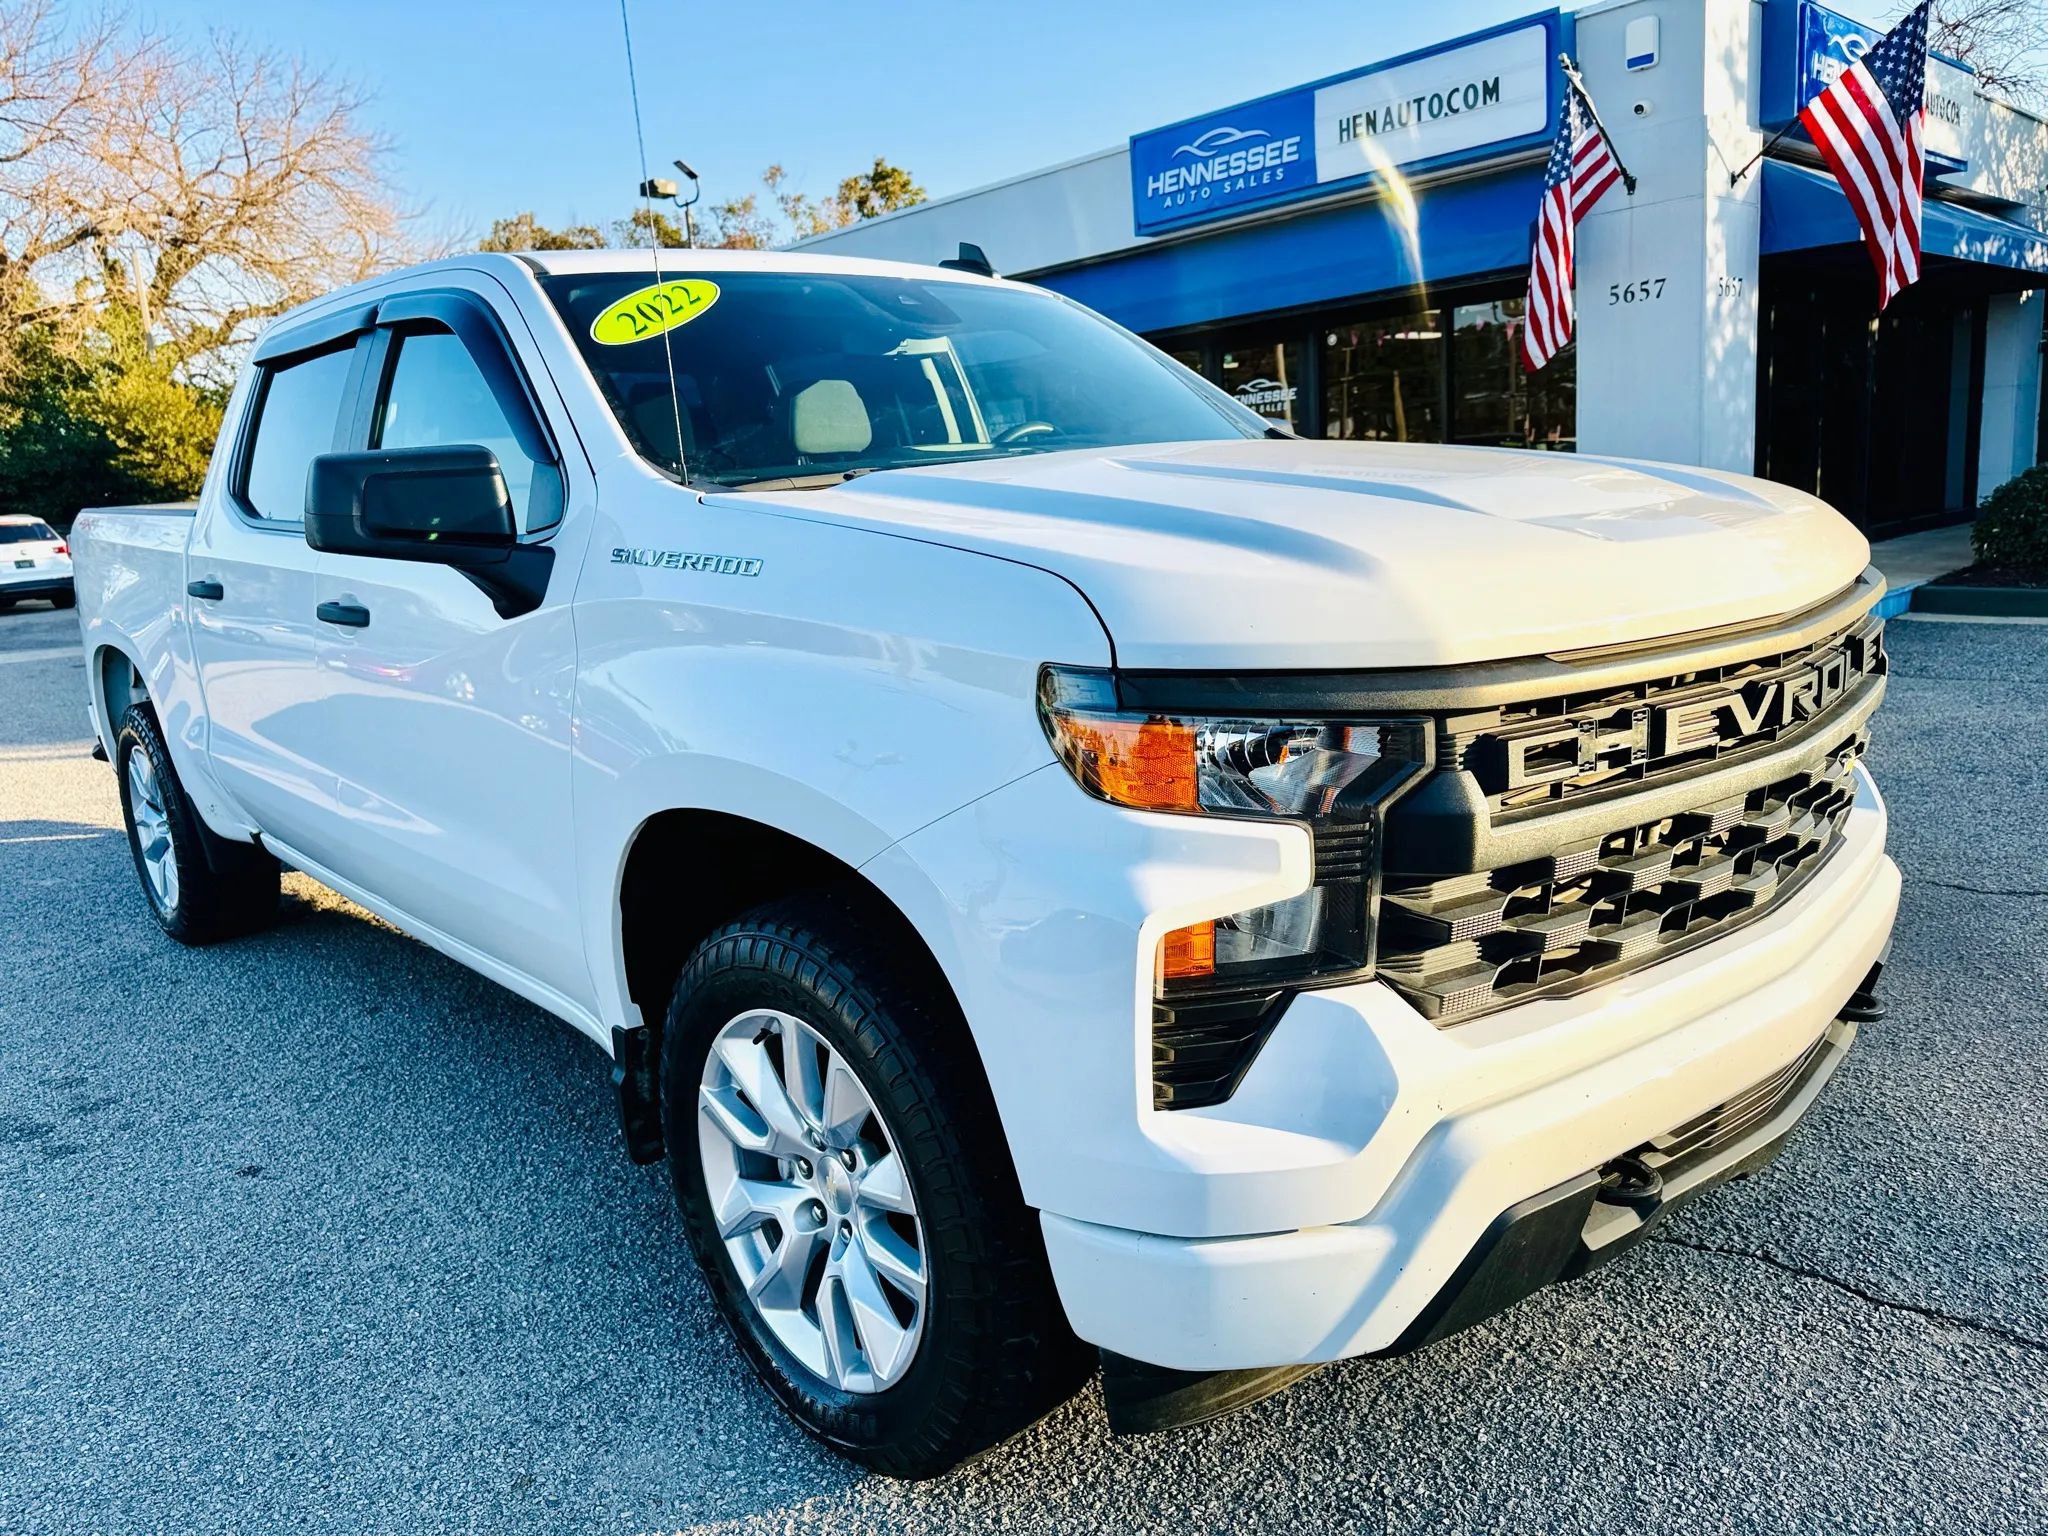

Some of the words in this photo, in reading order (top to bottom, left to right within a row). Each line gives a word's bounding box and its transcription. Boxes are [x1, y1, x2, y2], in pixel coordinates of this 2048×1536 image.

[1338, 76, 1500, 144] HENAUTO.COM
[1147, 135, 1301, 198] HENNESSEE
[1163, 187, 1211, 209] AUTO
[1223, 167, 1284, 194] SALES
[1609, 277, 1667, 306] 5657
[1718, 276, 1743, 297] 5657
[616, 285, 701, 335] 2022
[1233, 387, 1298, 405] ENNESSEE
[610, 548, 764, 577] SILVERADO
[1502, 618, 1886, 790] CHEVROLE
